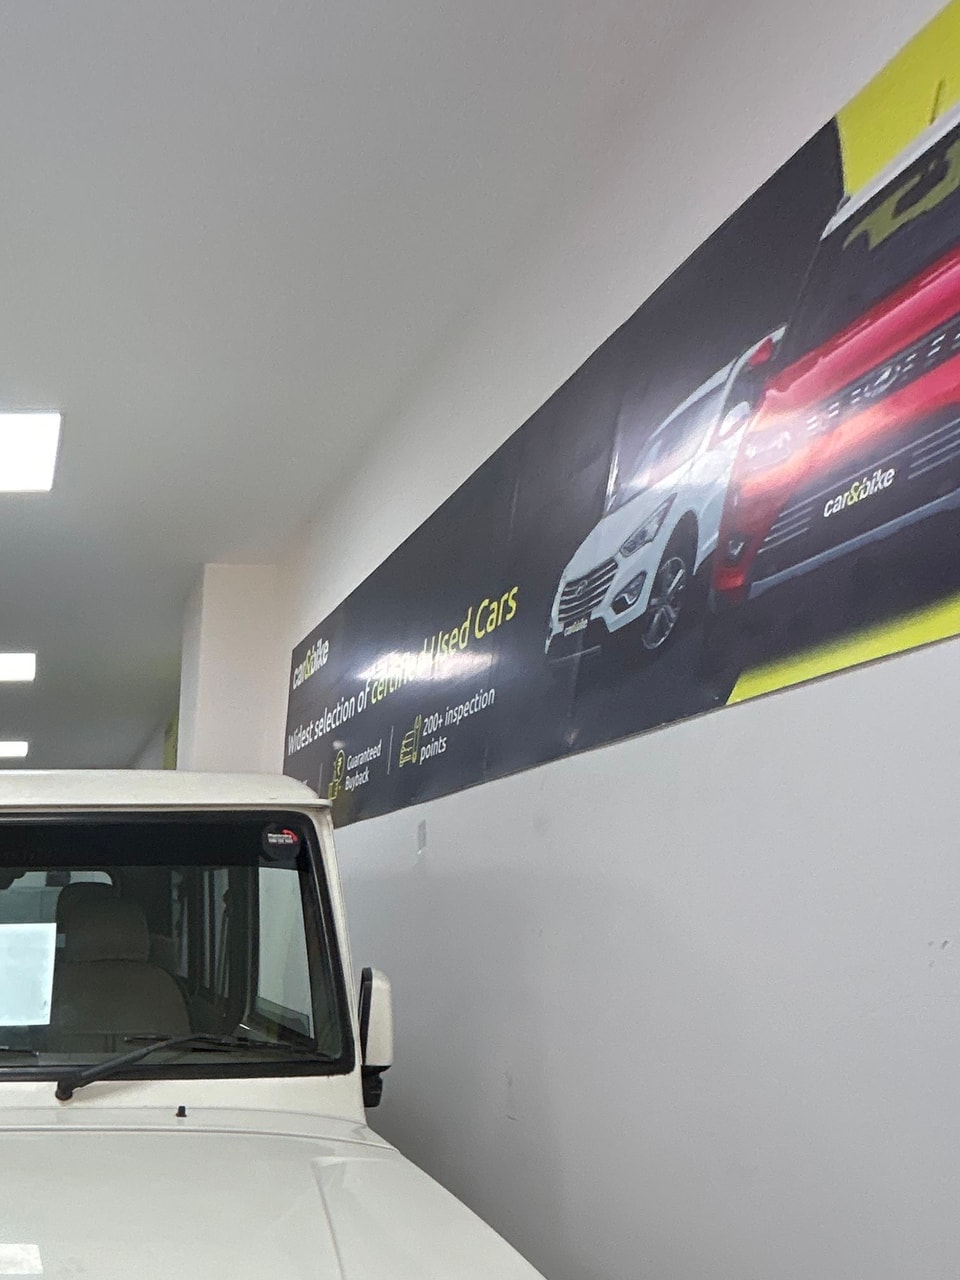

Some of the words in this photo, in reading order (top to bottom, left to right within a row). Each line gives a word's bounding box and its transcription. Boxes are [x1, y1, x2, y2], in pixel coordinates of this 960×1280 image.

[824, 468, 896, 517] car&bike
[288, 721, 314, 755] Widest
[313, 697, 355, 740] selection
[357, 681, 371, 713] of
[371, 638, 429, 705] certifd
[474, 586, 519, 640] Cars
[292, 638, 330, 690] car&bike
[422, 712, 443, 736] 200+
[444, 688, 495, 727] inspection
[346, 738, 382, 771] Guaranteed
[419, 735, 447, 765] points
[344, 766, 370, 791] Buyback
